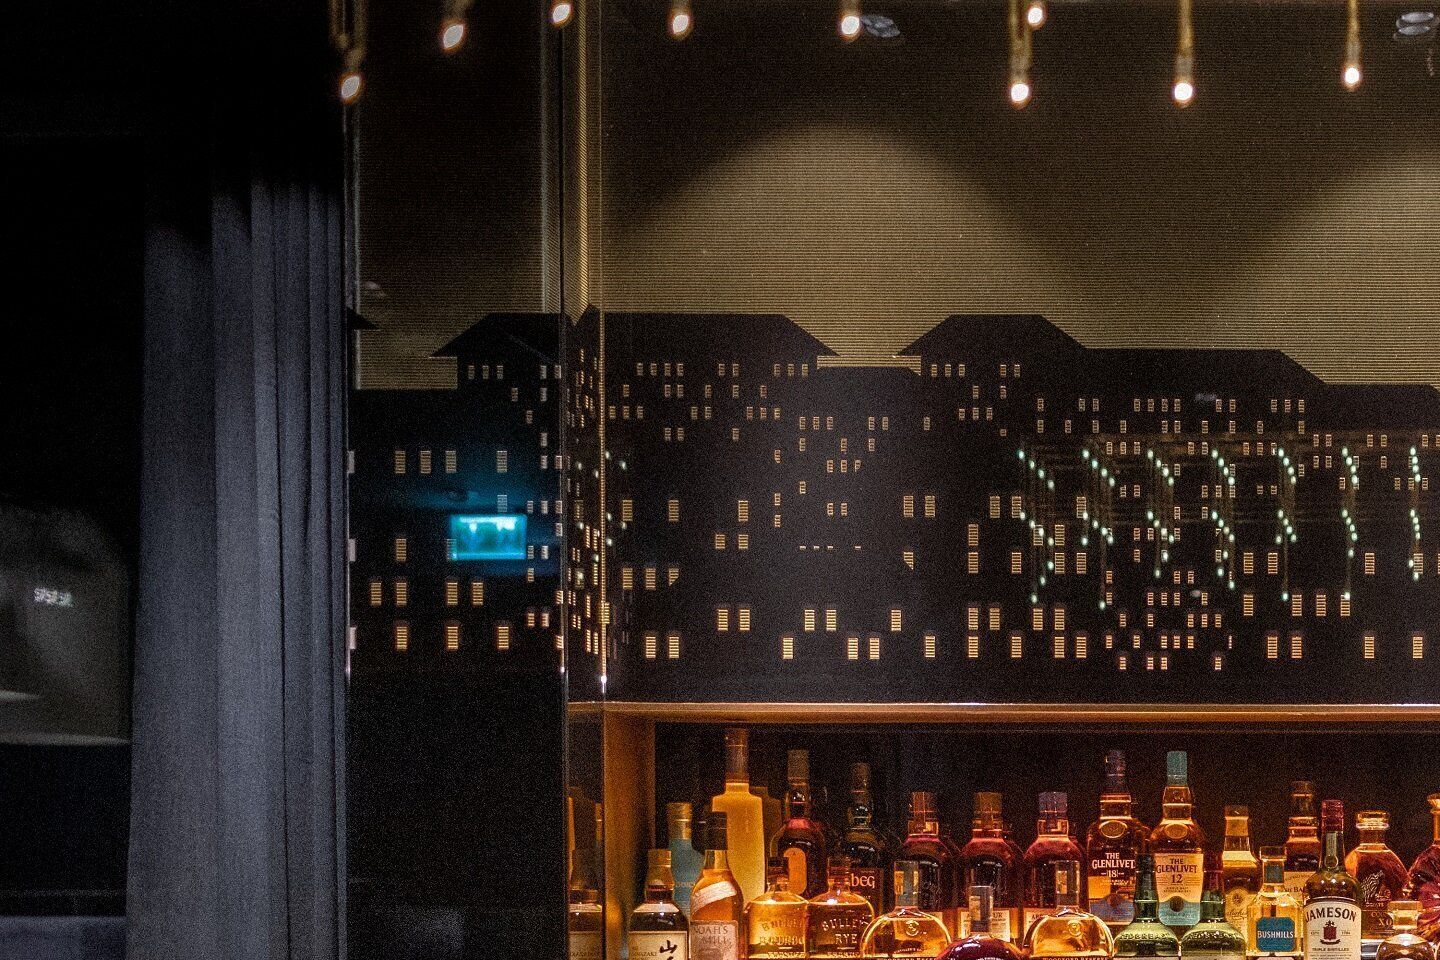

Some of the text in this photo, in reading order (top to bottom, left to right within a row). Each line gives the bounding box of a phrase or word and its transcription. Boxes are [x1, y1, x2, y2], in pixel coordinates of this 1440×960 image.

[1105, 852, 1120, 860] THE
[1092, 859, 1135, 869] GLENLIVET
[1156, 864, 1197, 874] GLENLIVET
[1171, 874, 1183, 883] 12
[1305, 907, 1357, 922] JAMESON
[835, 934, 858, 944] RYE
[1257, 930, 1294, 939] BUSHMILLS
